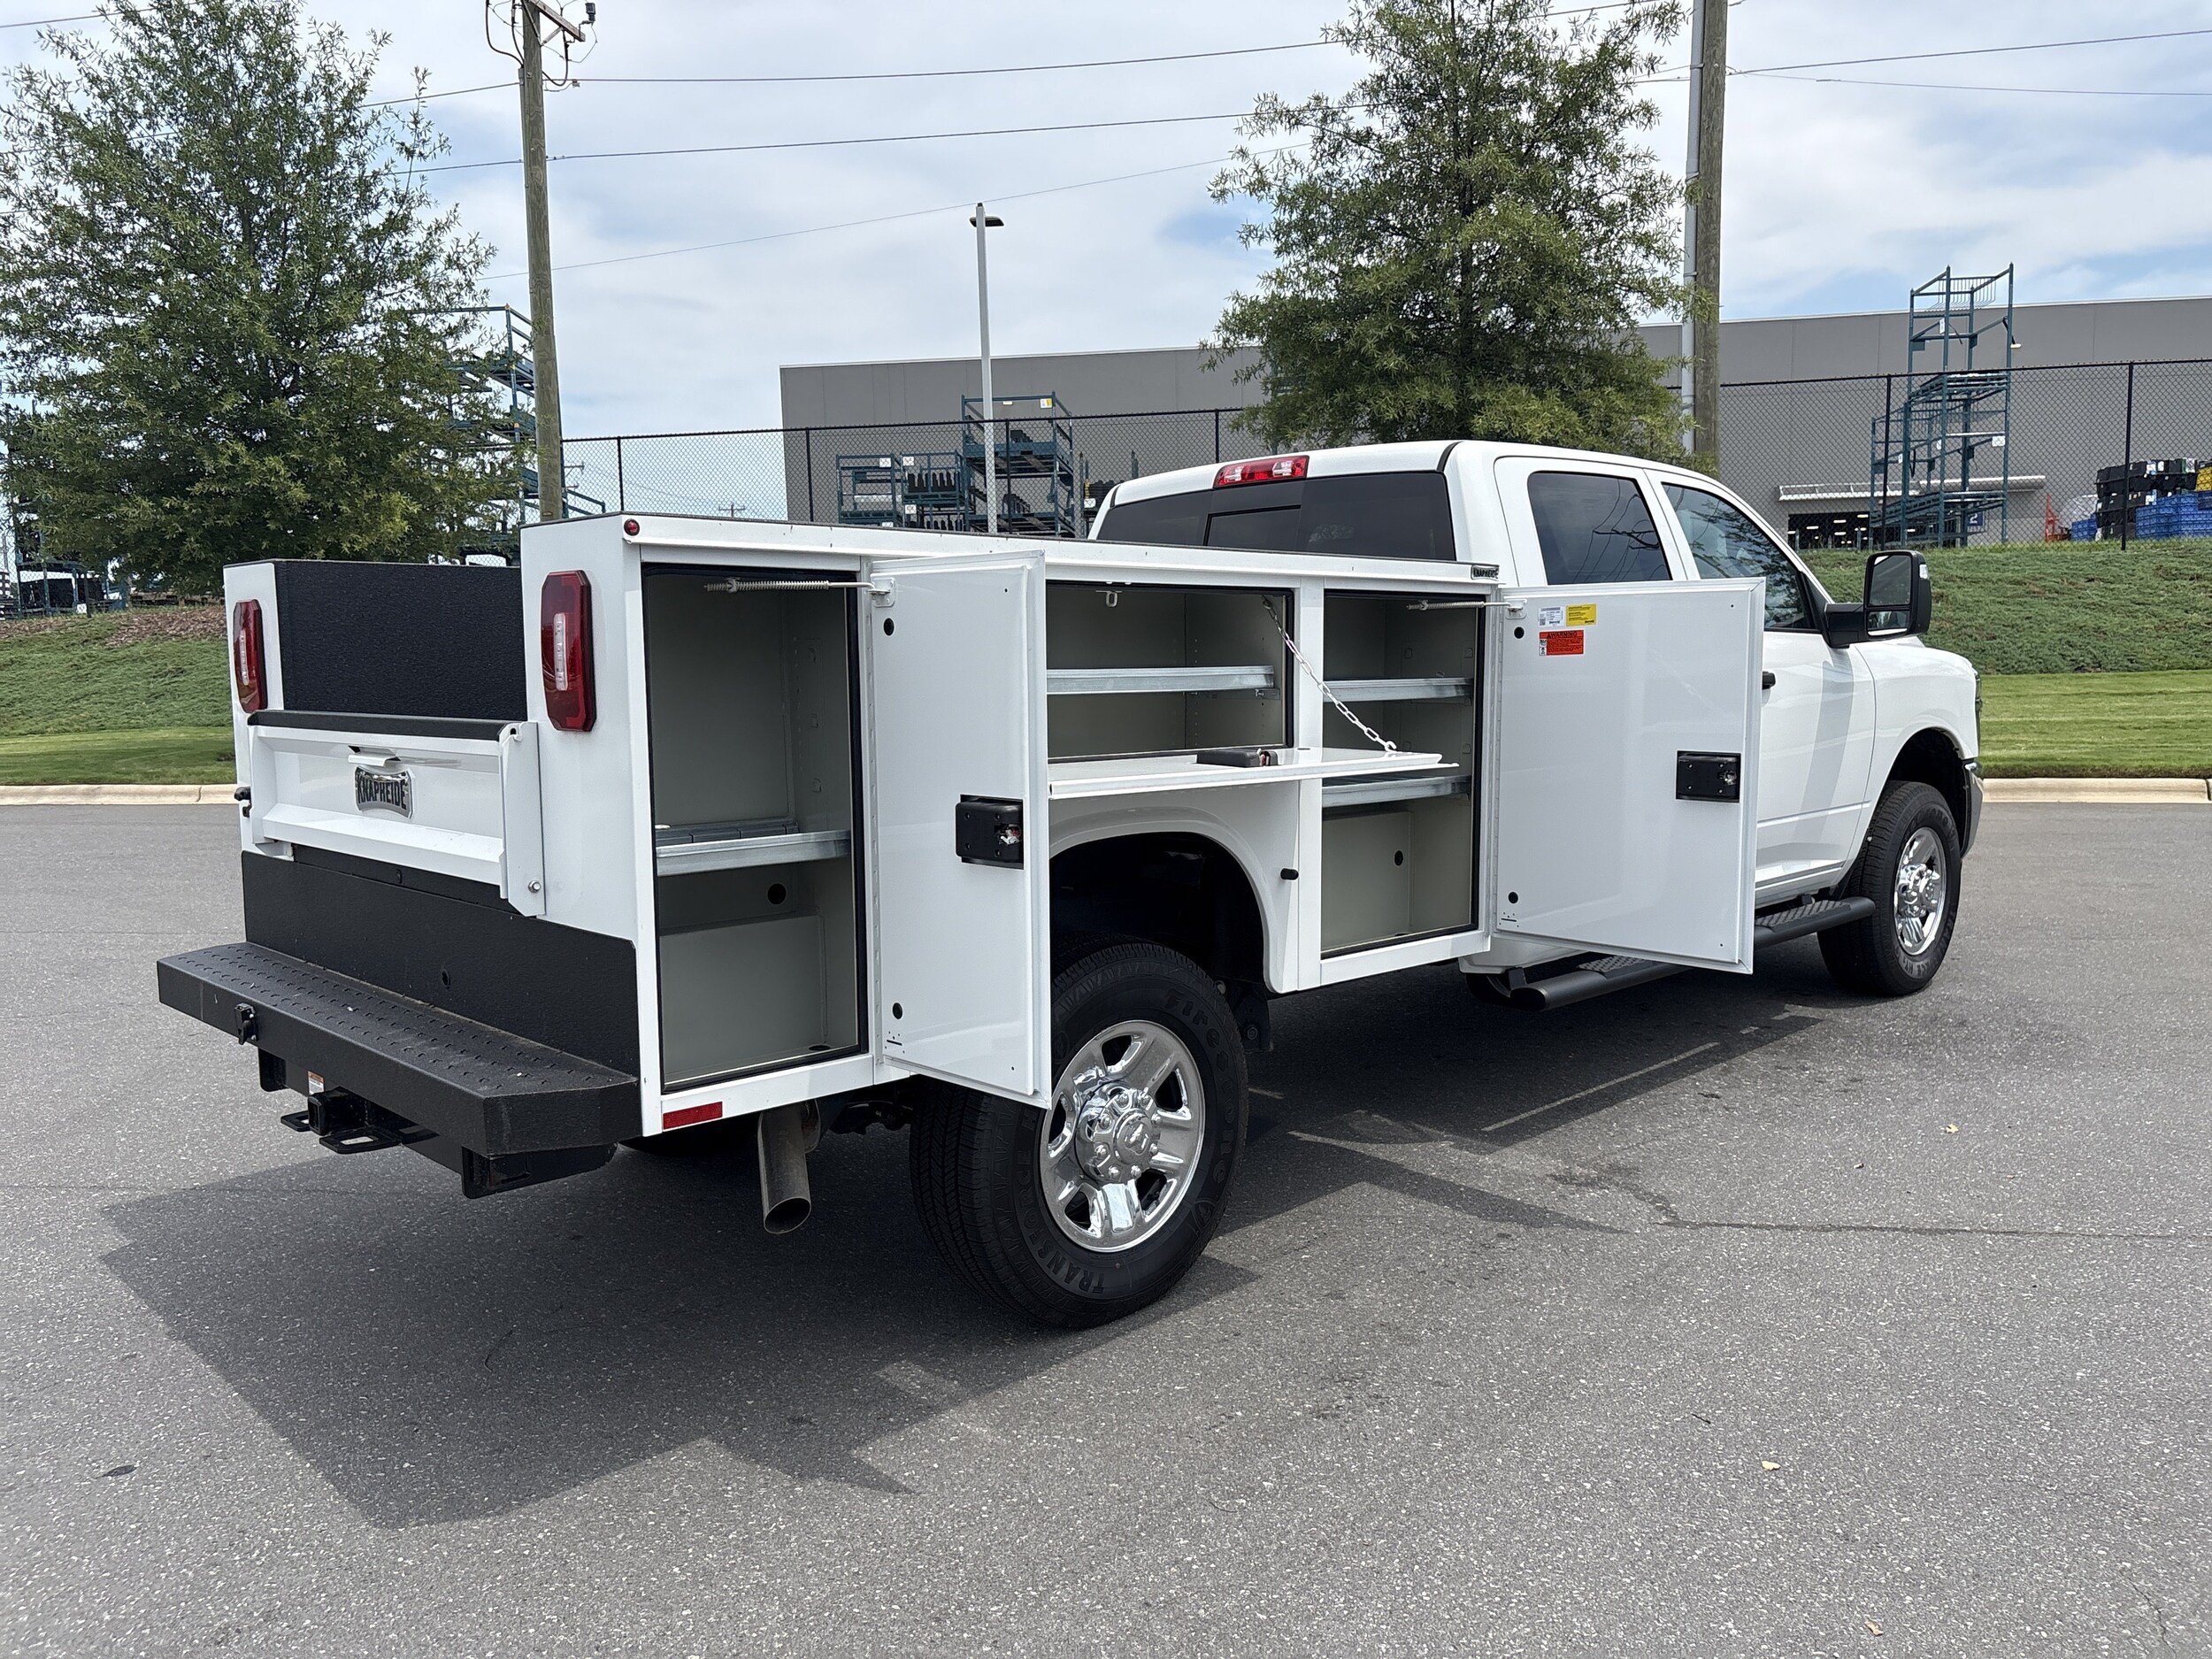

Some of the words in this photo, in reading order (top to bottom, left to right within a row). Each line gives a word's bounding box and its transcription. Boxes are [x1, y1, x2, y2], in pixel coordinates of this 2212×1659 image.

[357, 773, 408, 810] KNAPHEIDE
[1164, 987, 1236, 1184] Firestone
[1017, 1150, 1104, 1294] TRANSFORCE
